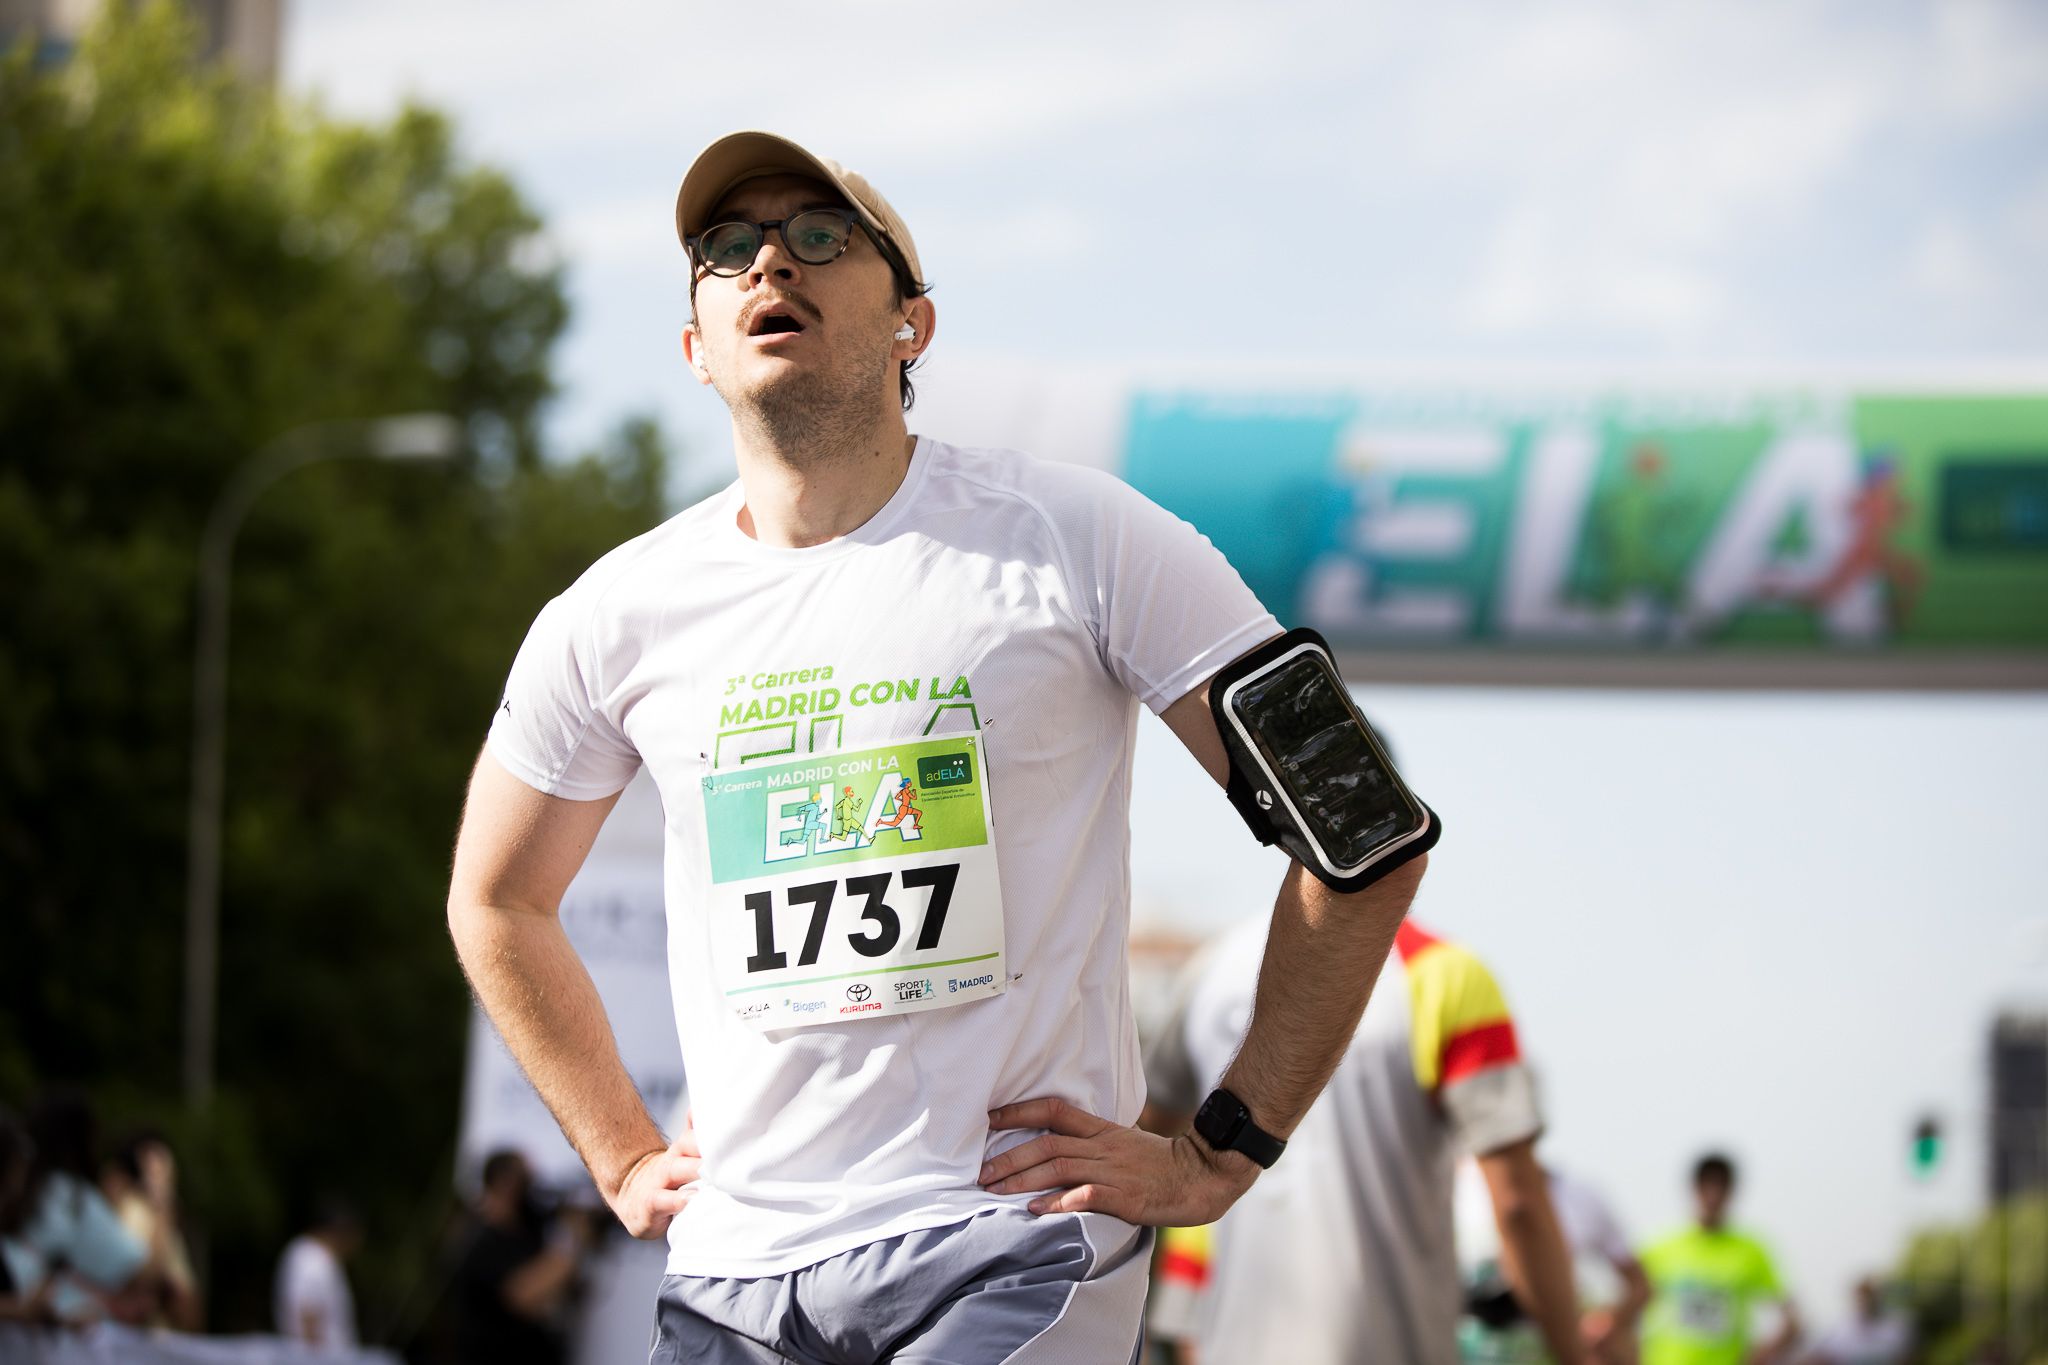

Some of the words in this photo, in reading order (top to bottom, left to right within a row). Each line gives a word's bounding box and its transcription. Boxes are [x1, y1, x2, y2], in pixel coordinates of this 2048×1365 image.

[1303, 428, 1892, 645] ELA
[751, 665, 834, 690] Carrera
[719, 687, 842, 727] MADRID
[849, 677, 921, 707] CON
[928, 675, 973, 700] LA
[724, 779, 762, 792] Carrera
[767, 767, 834, 789] MADRID
[837, 760, 873, 777] CON
[876, 755, 899, 771] LA
[926, 767, 965, 782] adELA
[763, 772, 923, 864] ELA
[744, 863, 961, 973] 1737
[894, 980, 925, 991] SPORT
[959, 974, 994, 989] MADRID
[793, 1001, 827, 1012] Biogen
[900, 989, 923, 1000] LIFE
